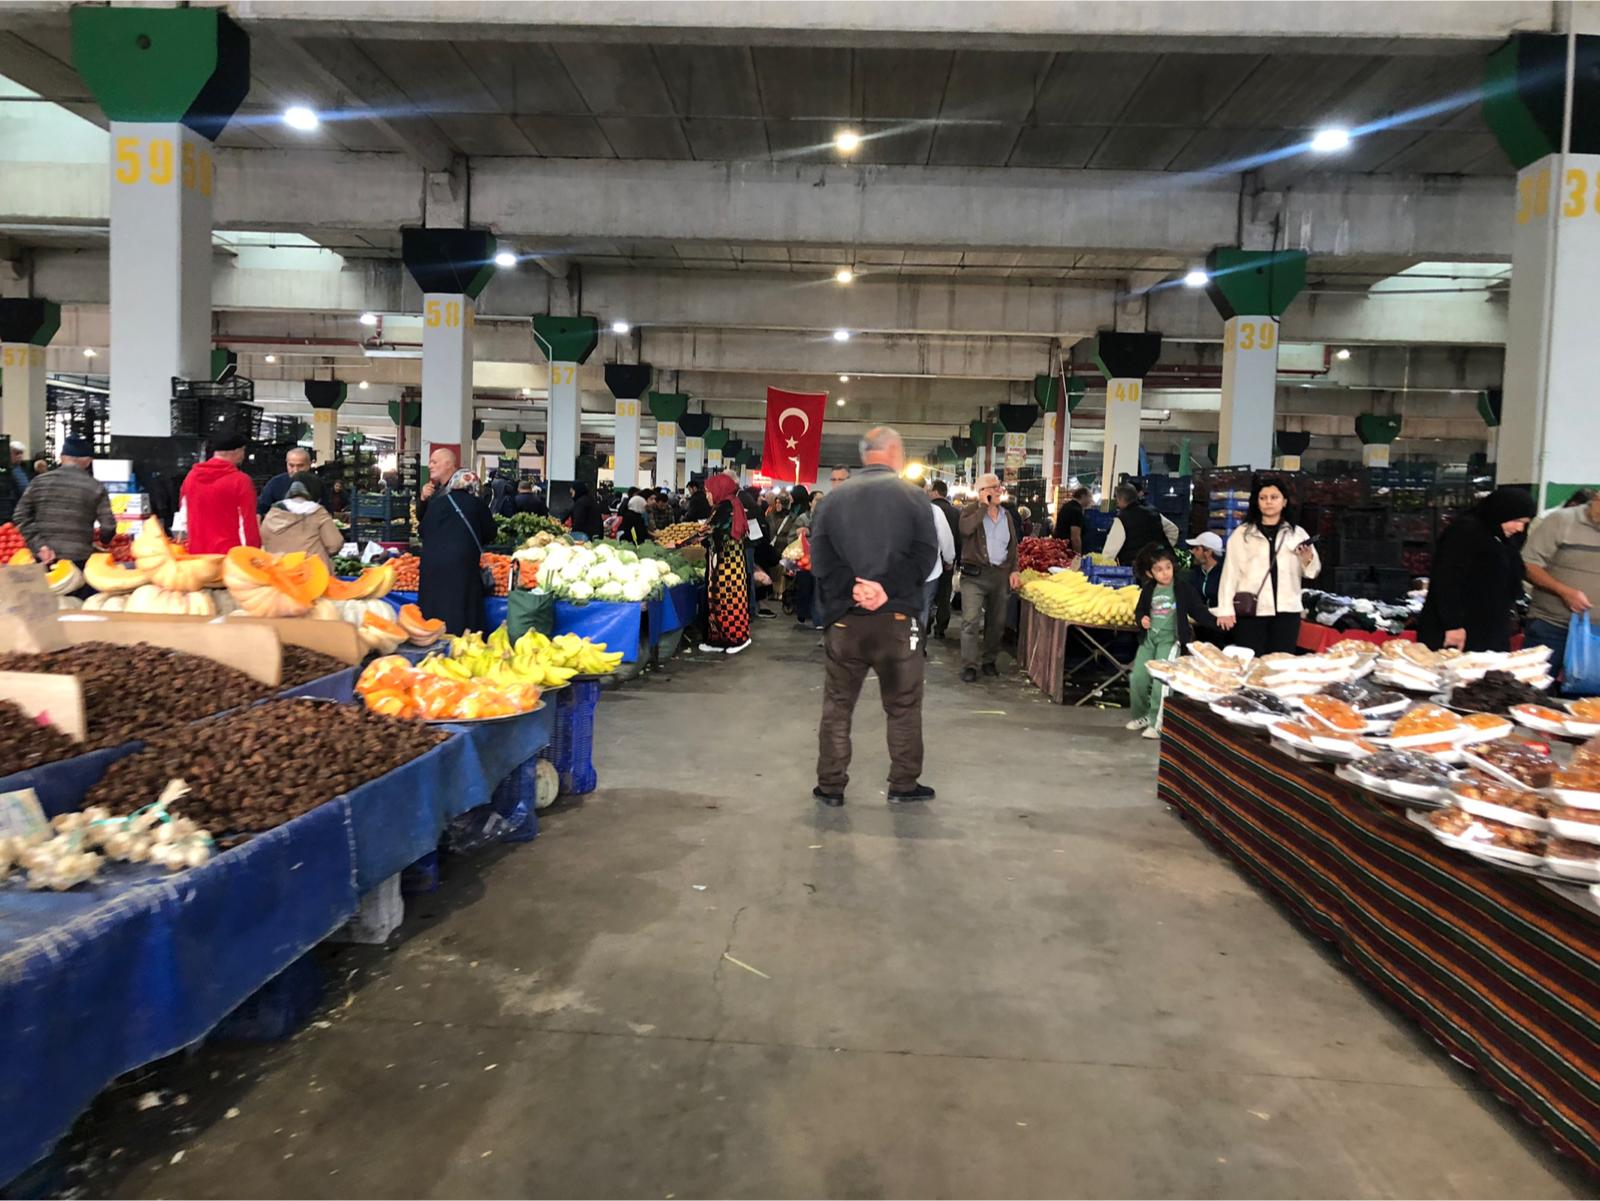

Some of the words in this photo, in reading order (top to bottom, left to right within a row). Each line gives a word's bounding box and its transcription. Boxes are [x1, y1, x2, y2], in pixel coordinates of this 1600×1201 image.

[115, 137, 173, 185] 59
[1563, 168, 1600, 218] 3
[1240, 323, 1275, 350] 39
[551, 367, 576, 385] 57
[1115, 383, 1140, 402] 40
[1009, 433, 1025, 447] 42
